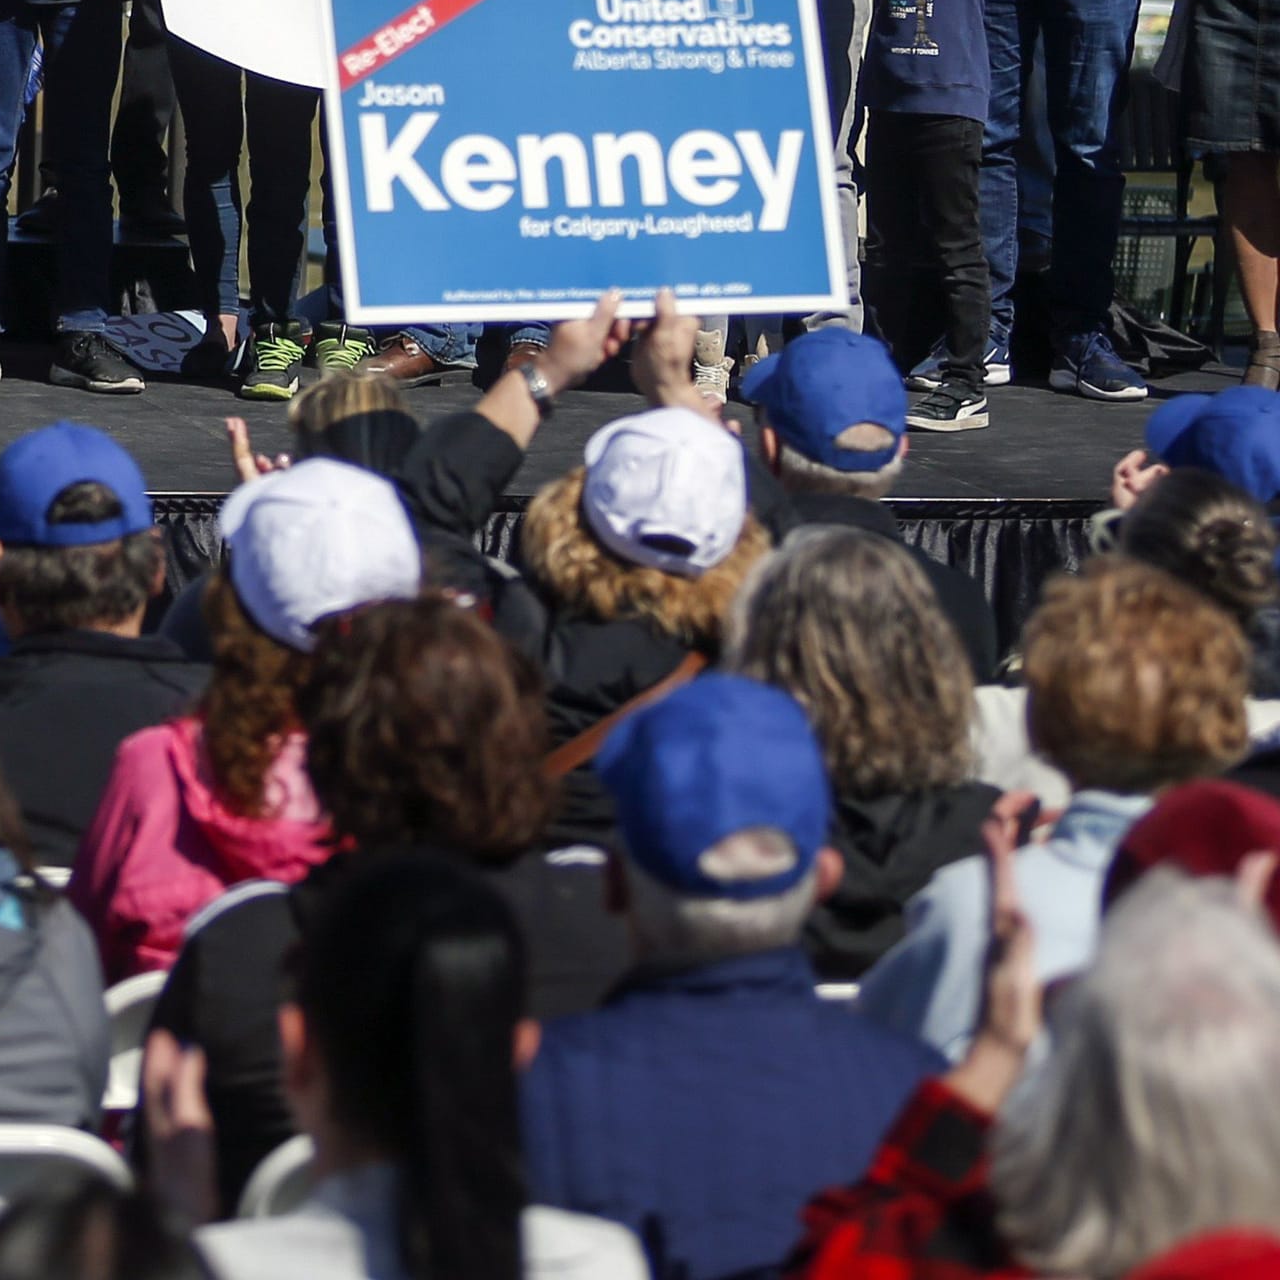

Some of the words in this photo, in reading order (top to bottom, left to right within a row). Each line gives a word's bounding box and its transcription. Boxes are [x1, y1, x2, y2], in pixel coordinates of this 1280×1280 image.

[341, 3, 437, 78] Re-Elect
[568, 19, 792, 49] Conservatives
[573, 49, 651, 71] Alberta
[653, 49, 725, 73] Strong
[727, 50, 745, 68] &
[747, 49, 795, 68] Free
[358, 81, 445, 108] Jason
[358, 111, 804, 232] Kenney
[519, 217, 551, 238] for
[553, 212, 754, 241] Calgary-Lougheed
